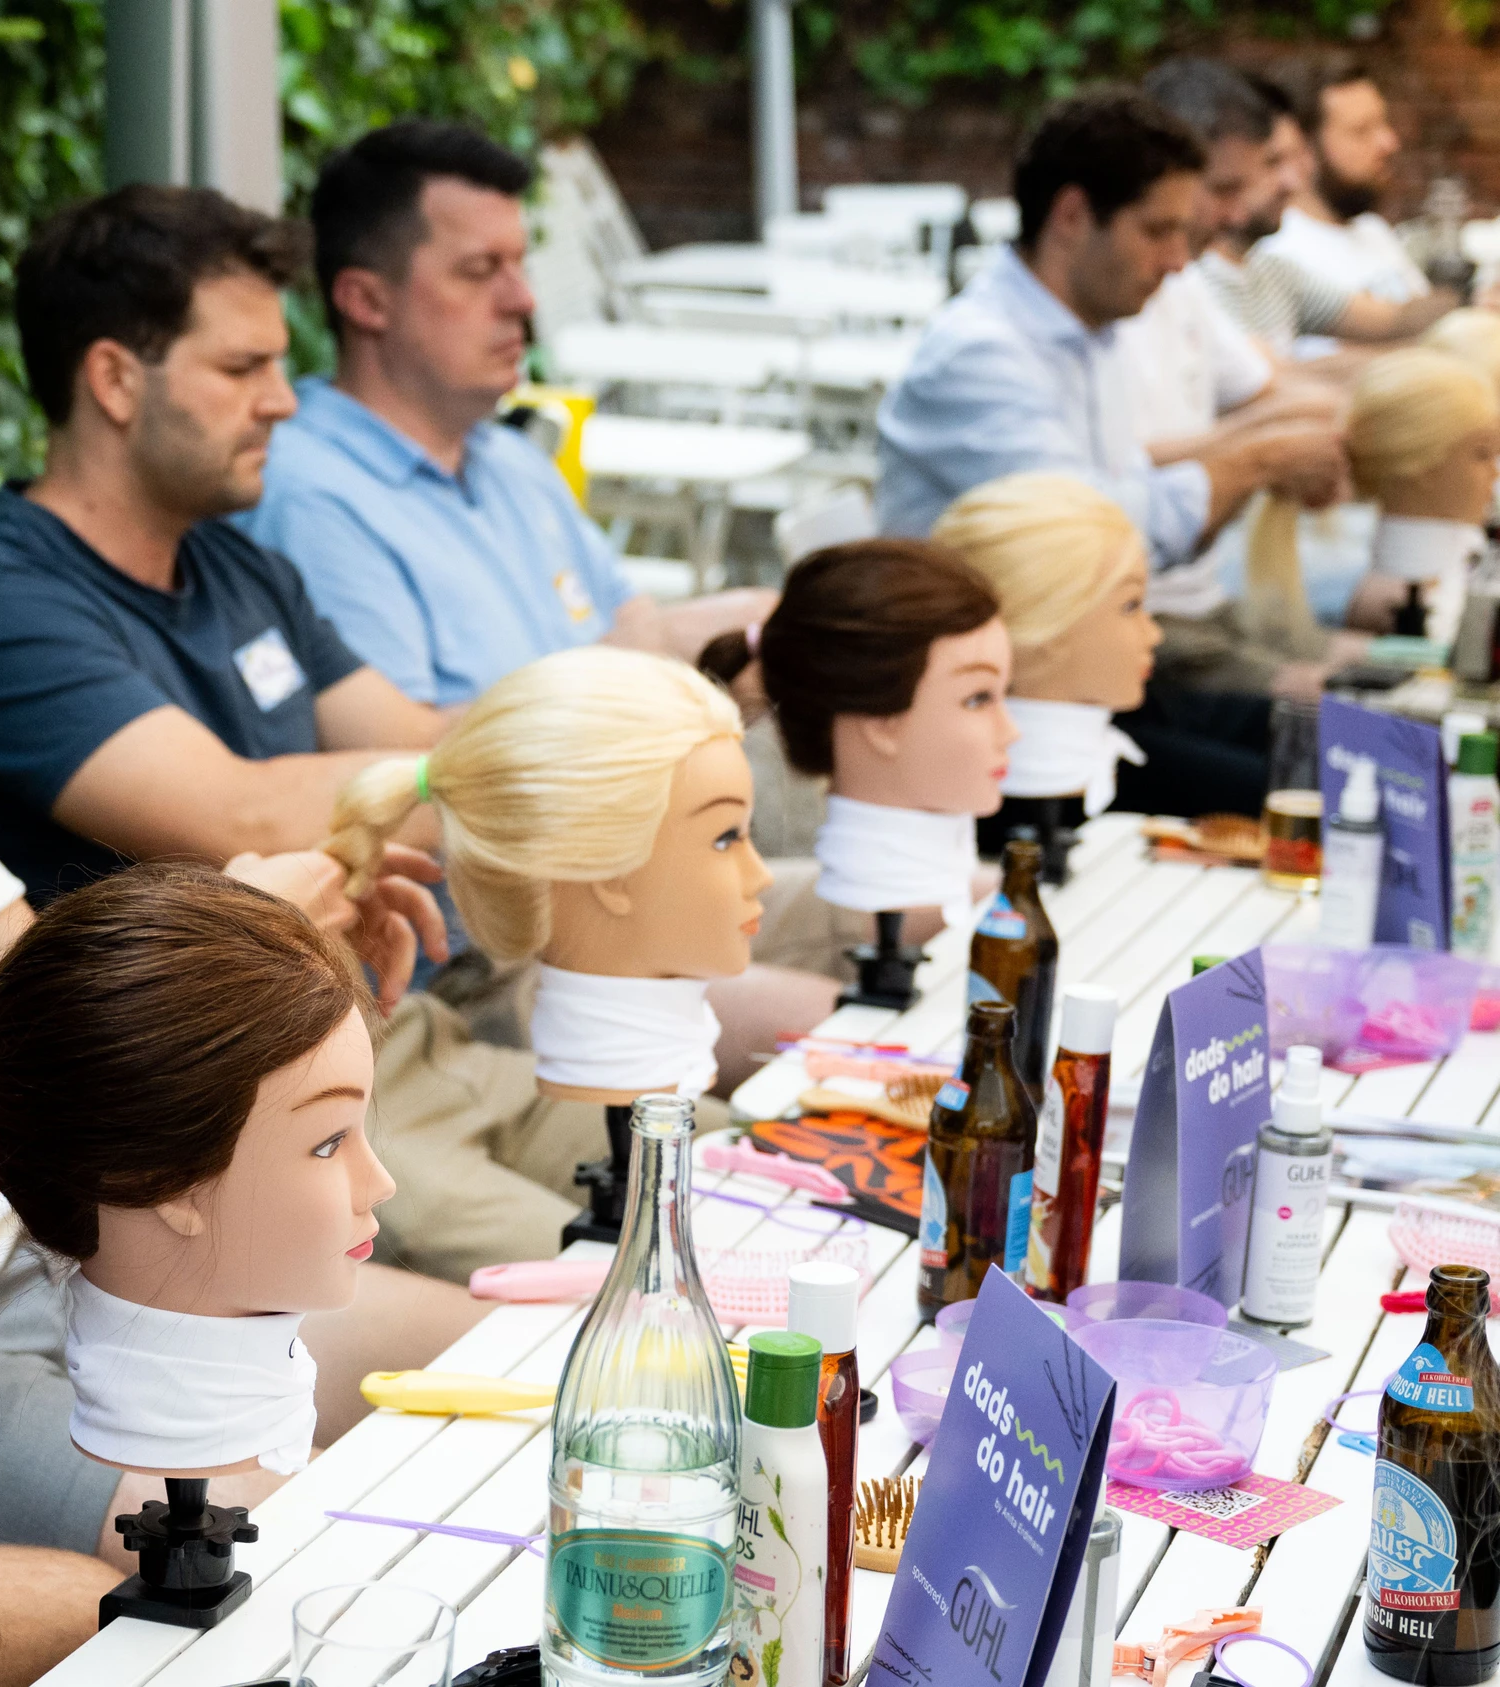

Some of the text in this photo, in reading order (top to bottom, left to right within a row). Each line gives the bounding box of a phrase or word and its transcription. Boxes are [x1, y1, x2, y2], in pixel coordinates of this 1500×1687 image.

[1184, 1037, 1227, 1082] dads
[1208, 1070, 1231, 1105] do
[1231, 1047, 1266, 1092] hair
[963, 1361, 1015, 1436] dads
[1421, 1373, 1468, 1386] ALKOHOLFREI
[1426, 1387, 1463, 1407] HELL
[976, 1433, 1005, 1484] do
[1005, 1458, 1056, 1536] hair
[563, 1559, 719, 1606] TAUNUSQUELLE
[911, 1565, 950, 1617] sponsored by
[1383, 1592, 1456, 1607] ALKOHOLFREI
[949, 1576, 1008, 1682] GUHL
[1399, 1616, 1435, 1640] HELL
